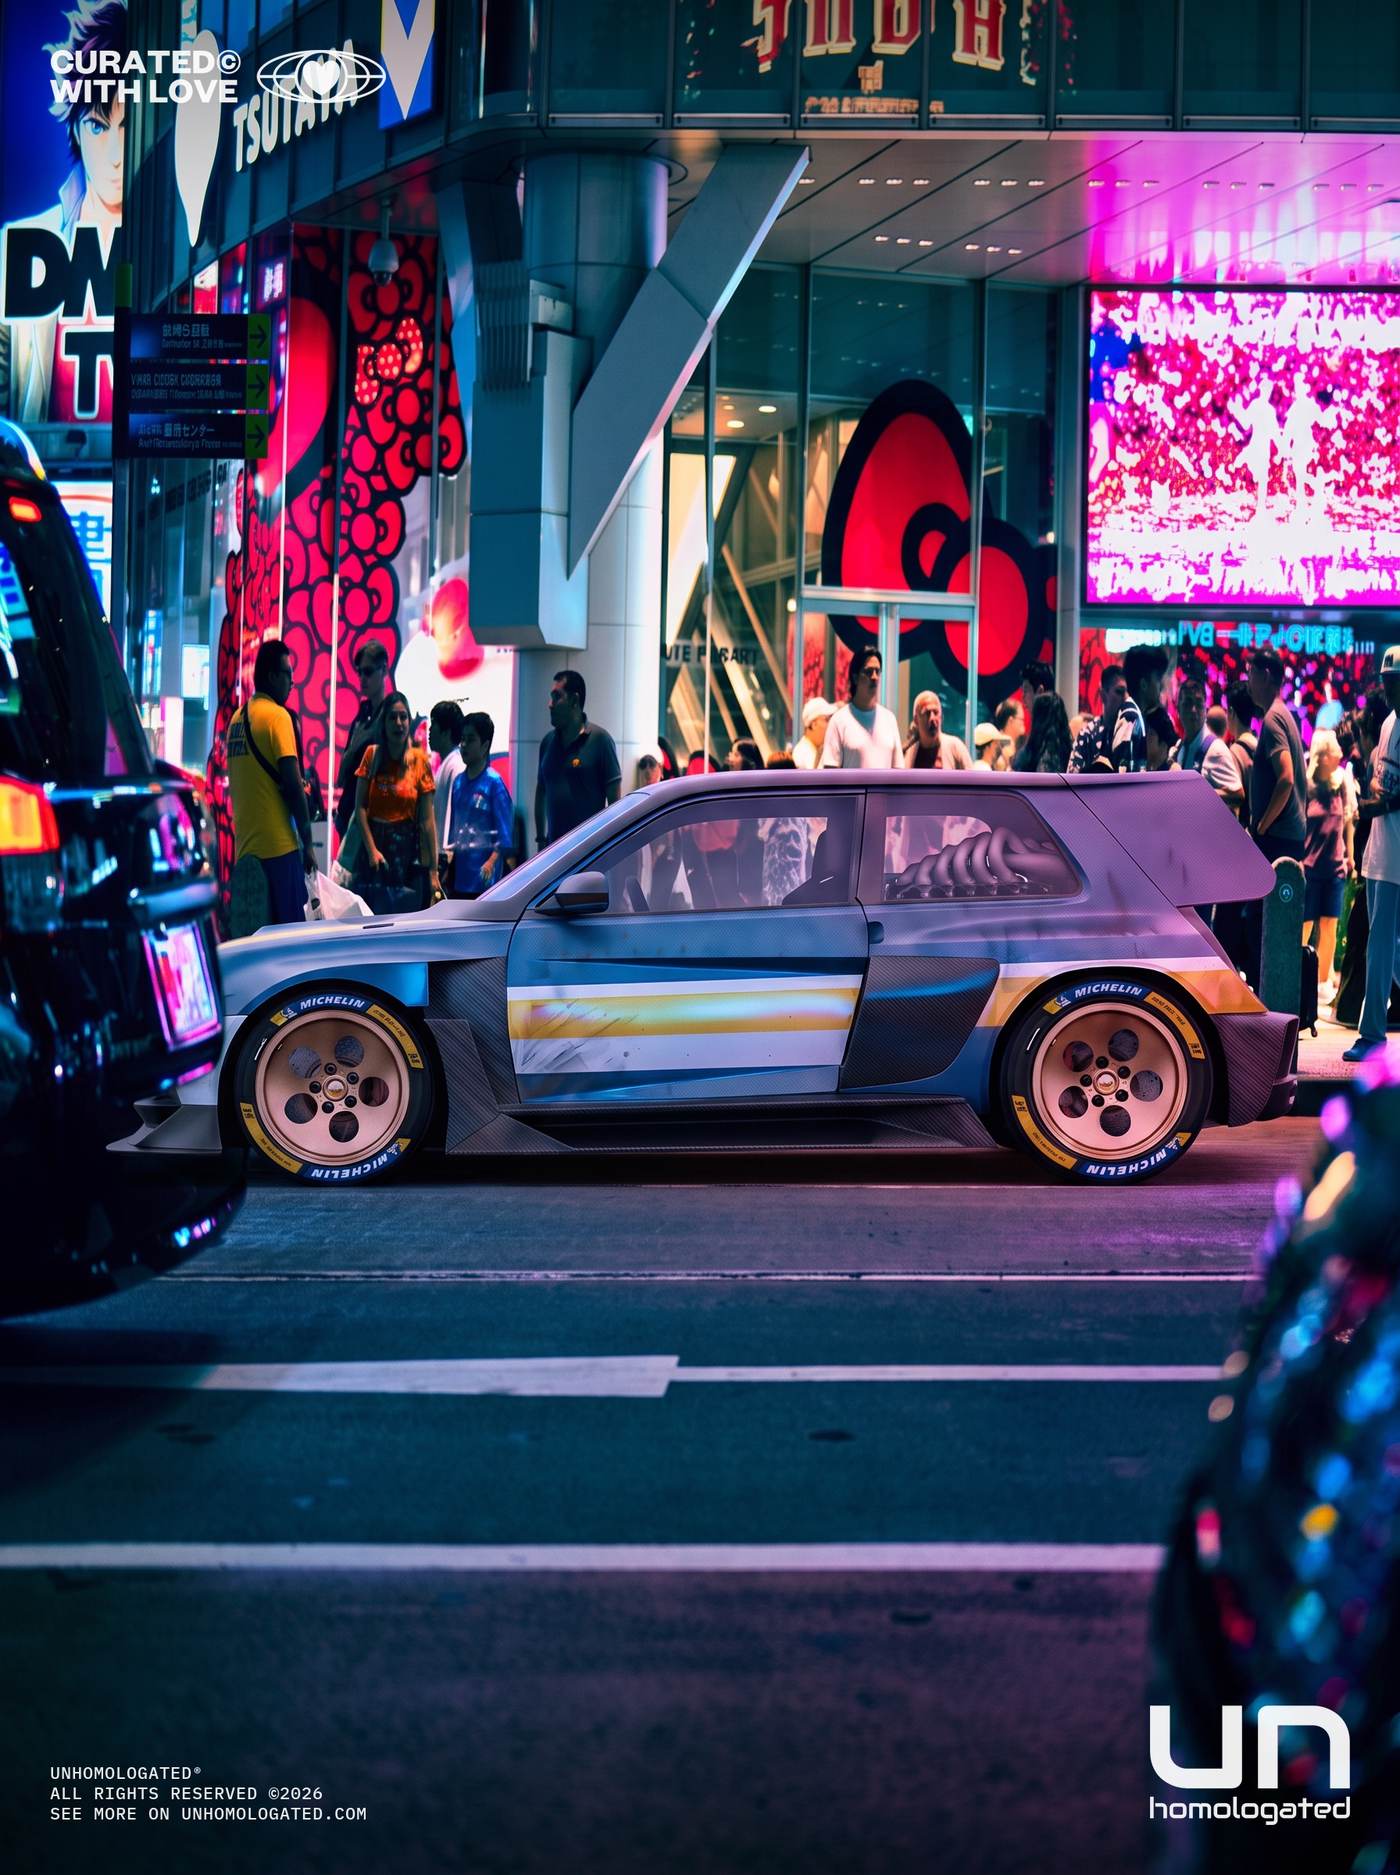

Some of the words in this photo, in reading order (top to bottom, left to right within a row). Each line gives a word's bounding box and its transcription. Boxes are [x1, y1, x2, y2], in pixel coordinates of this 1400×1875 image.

[1075, 983, 1143, 999] MICHELIN
[300, 996, 366, 1010] MICHELIN
[310, 1153, 388, 1179] MICHELIN
[1086, 1148, 1167, 1176] MICHELIN
